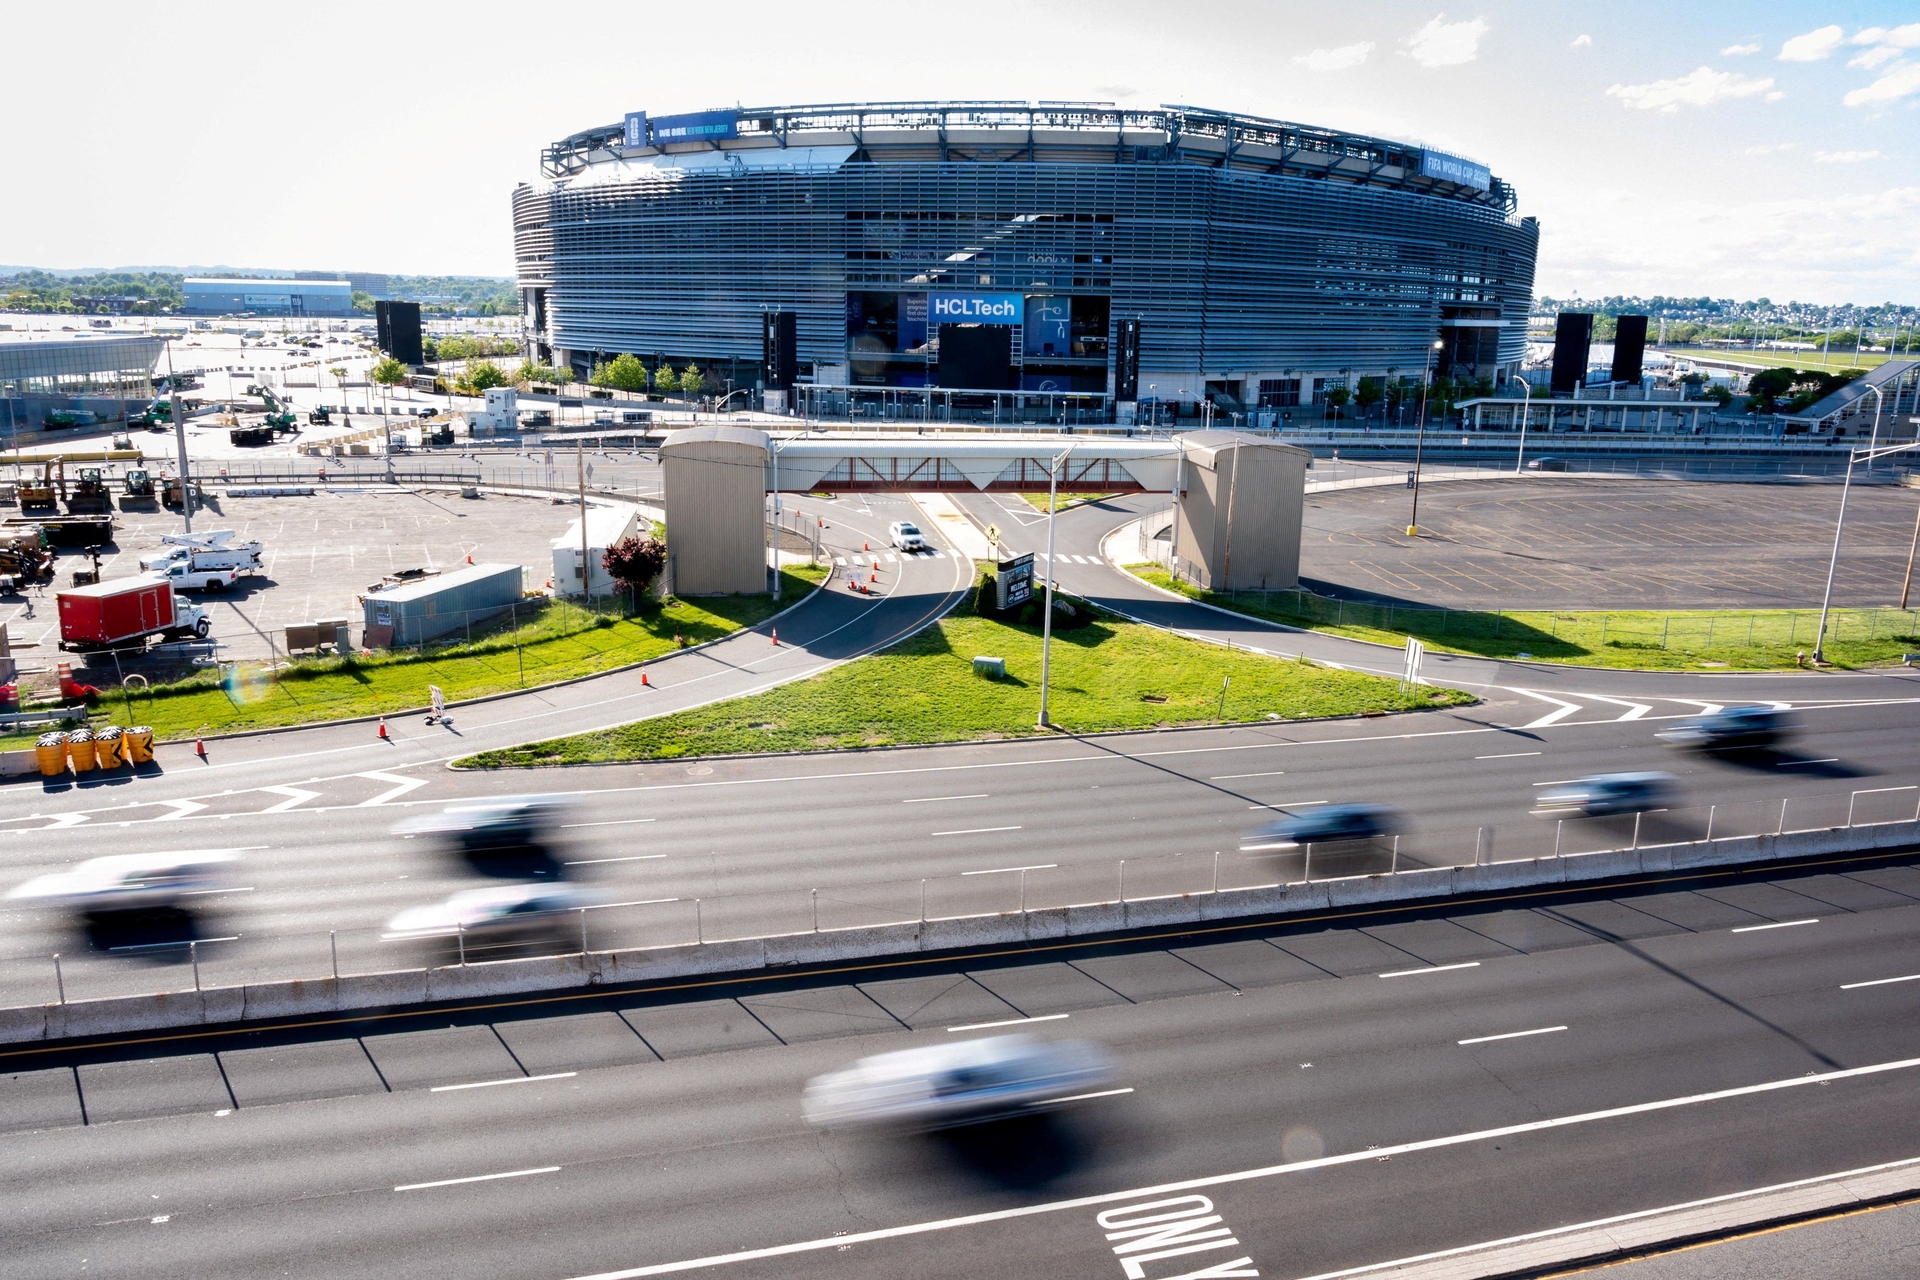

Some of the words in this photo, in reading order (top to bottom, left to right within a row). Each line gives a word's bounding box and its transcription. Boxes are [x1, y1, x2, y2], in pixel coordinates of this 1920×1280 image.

[1428, 157, 1441, 171] FIFA
[1442, 160, 1462, 176] WORLD
[1463, 166, 1473, 178] CUP
[935, 298, 1015, 316] HCLTech
[1097, 1194, 1260, 1280] ONLY
